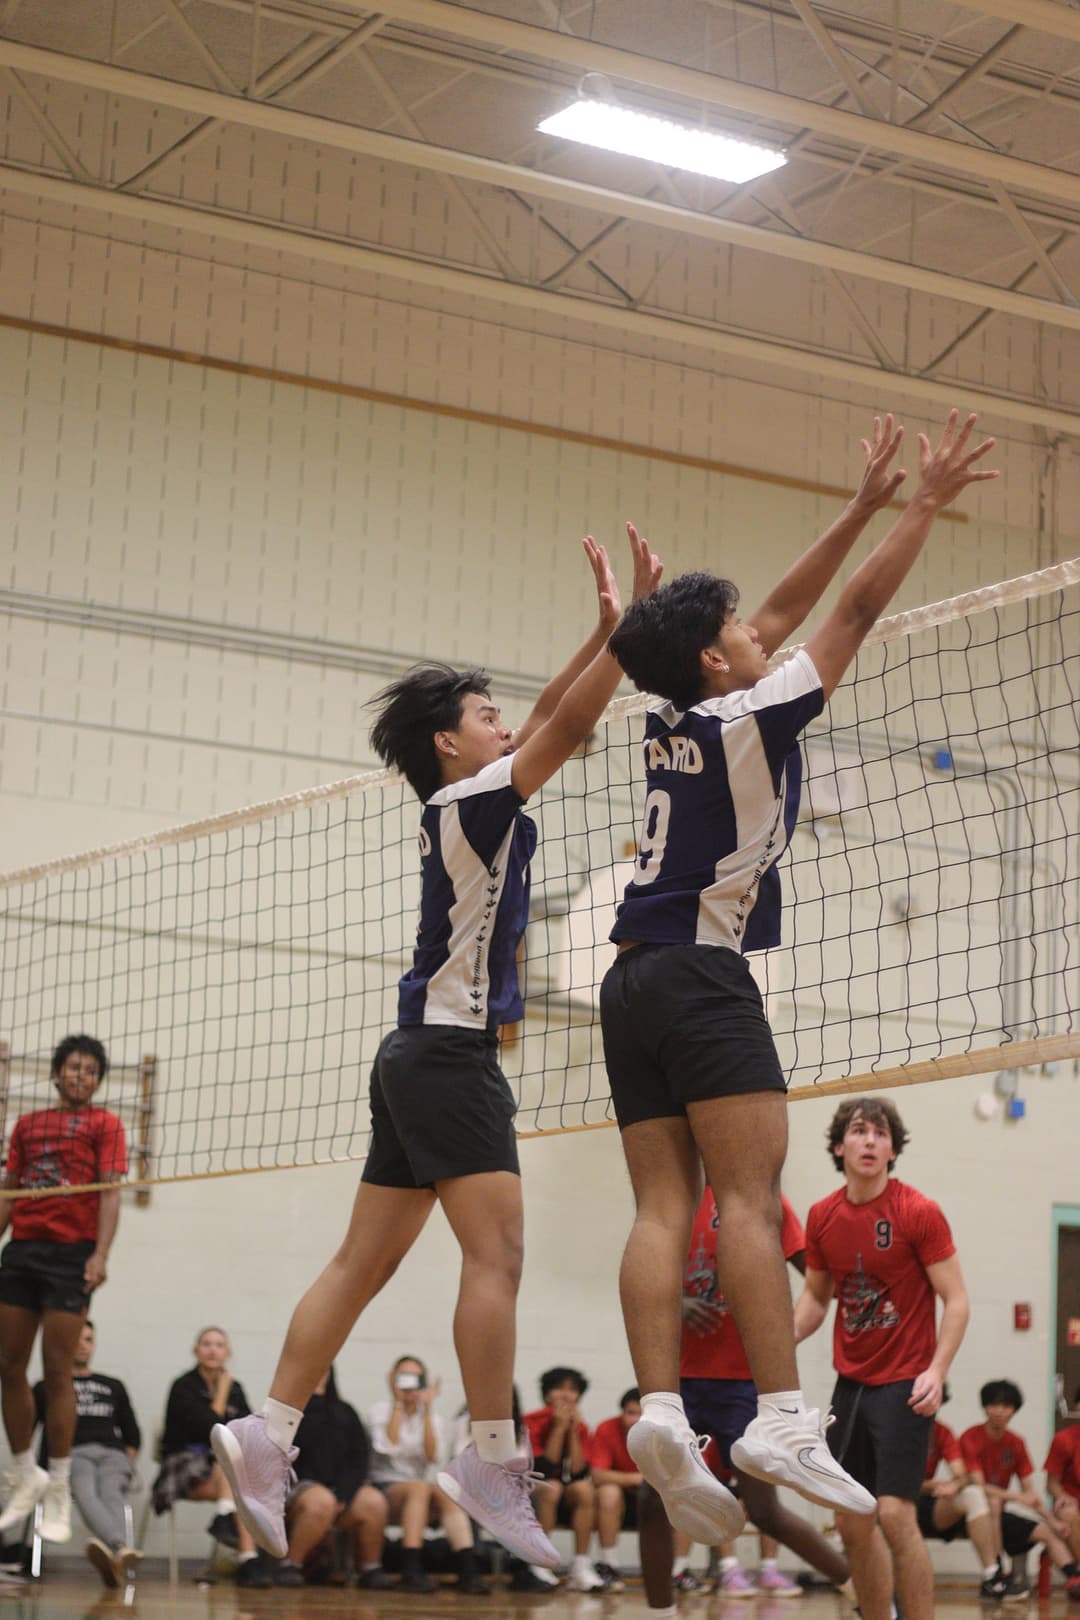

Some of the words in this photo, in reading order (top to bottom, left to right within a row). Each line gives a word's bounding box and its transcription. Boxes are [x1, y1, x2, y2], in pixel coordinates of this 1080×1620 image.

[643, 736, 704, 775] ARD
[632, 789, 672, 886] 9
[875, 1218, 892, 1250] 9
